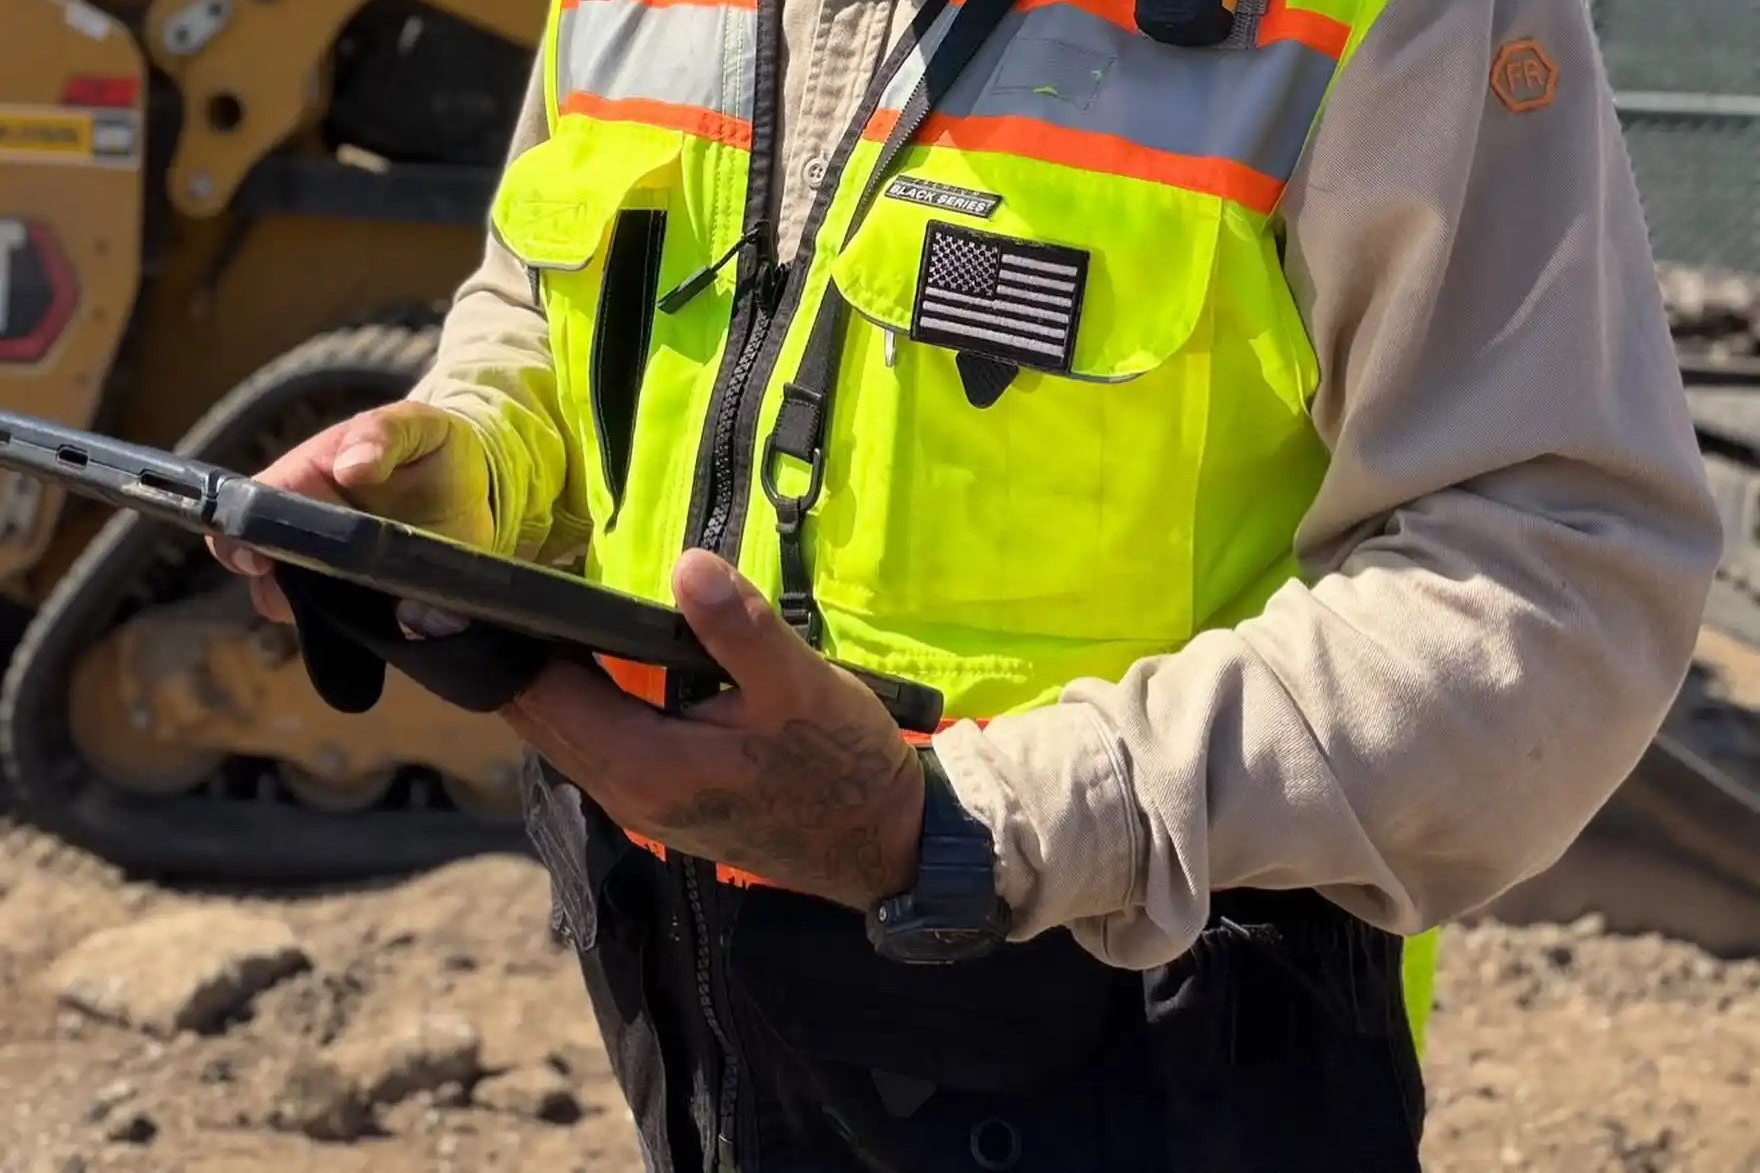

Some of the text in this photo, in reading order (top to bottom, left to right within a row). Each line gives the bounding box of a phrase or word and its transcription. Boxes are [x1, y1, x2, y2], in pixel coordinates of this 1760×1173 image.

[1505, 59, 1544, 93] FR
[889, 184, 934, 201] BLACK
[936, 193, 986, 213] SERIES
